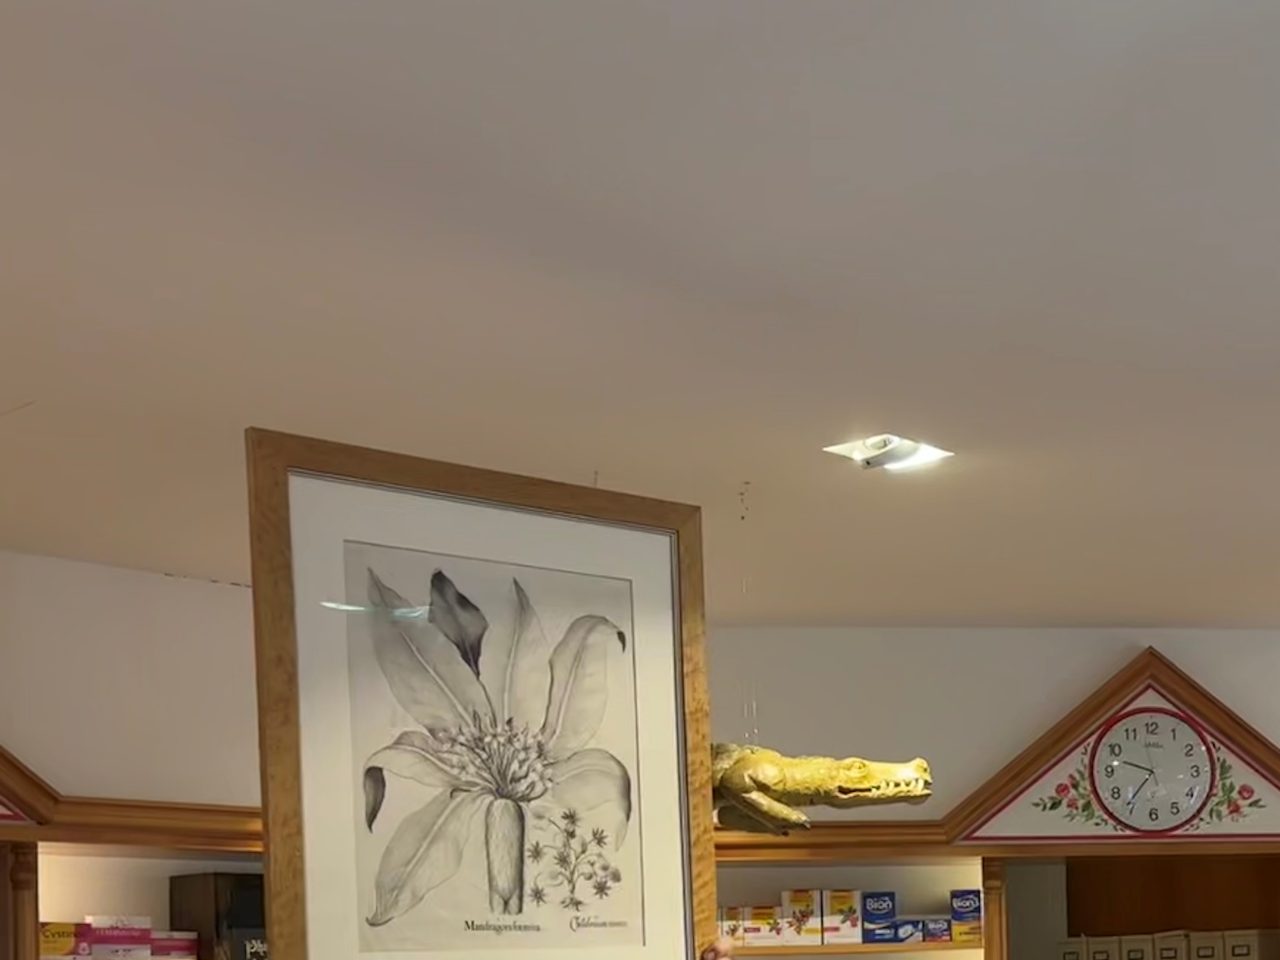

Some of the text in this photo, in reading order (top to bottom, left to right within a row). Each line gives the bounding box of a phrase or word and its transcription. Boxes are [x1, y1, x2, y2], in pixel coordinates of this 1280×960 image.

[1124, 728, 1137, 741] 11
[1145, 722, 1159, 735] 12
[1170, 728, 1177, 741] 1
[1109, 744, 1122, 757] 10
[1185, 744, 1194, 757] 2
[1105, 766, 1114, 778] 9
[1190, 765, 1200, 778] 3
[1111, 787, 1121, 800] 8
[1186, 787, 1194, 799] 4
[1170, 802, 1180, 815] 5
[1149, 809, 1159, 822] 6
